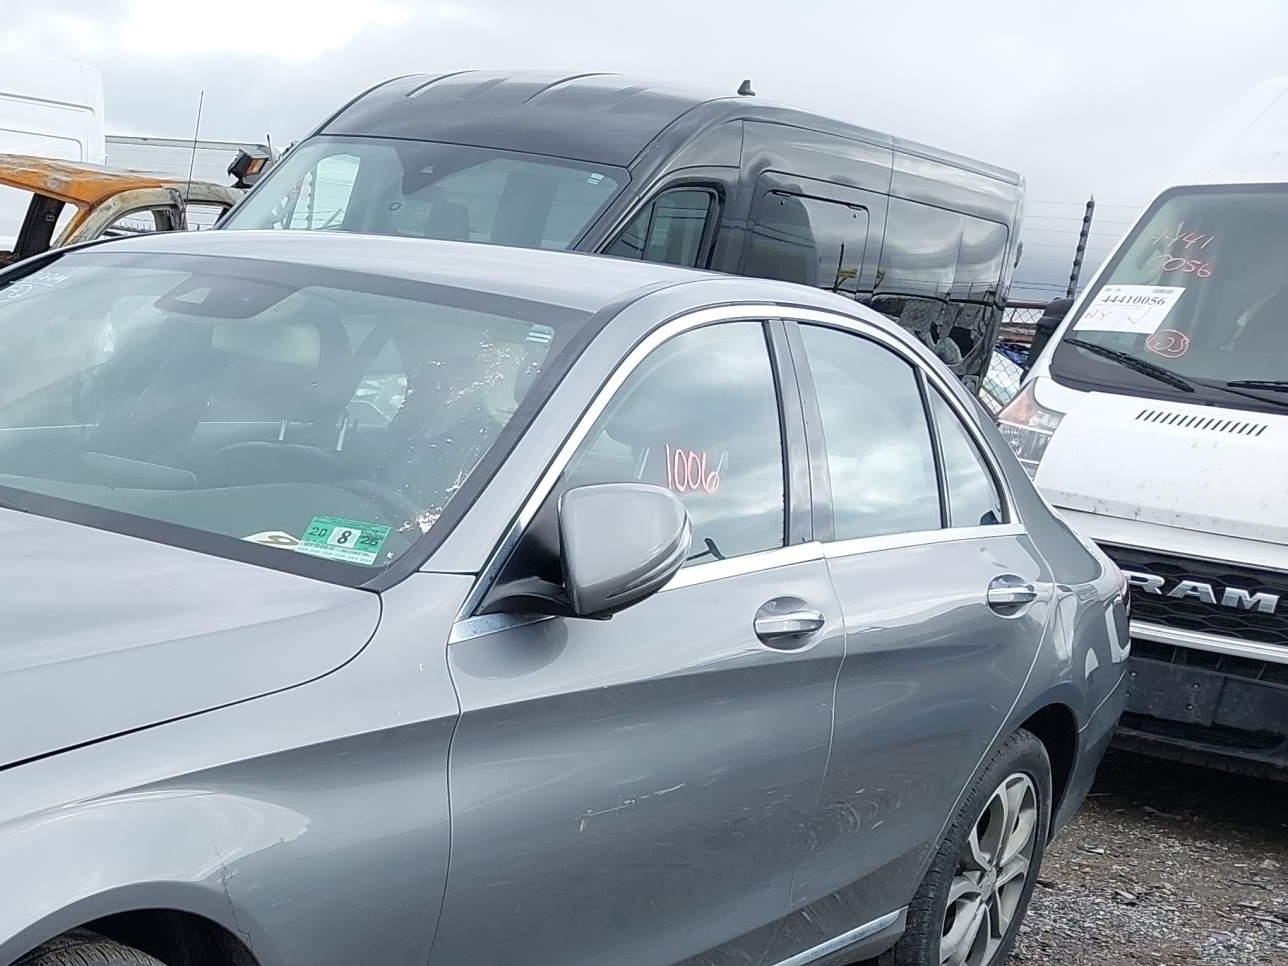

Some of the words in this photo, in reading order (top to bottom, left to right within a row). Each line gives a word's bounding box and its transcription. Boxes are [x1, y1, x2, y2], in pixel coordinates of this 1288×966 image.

[1101, 294, 1167, 306] 44410056
[665, 442, 721, 495] 1006
[309, 526, 328, 538] 20
[336, 530, 352, 545] 8
[1120, 569, 1280, 614] RAM
